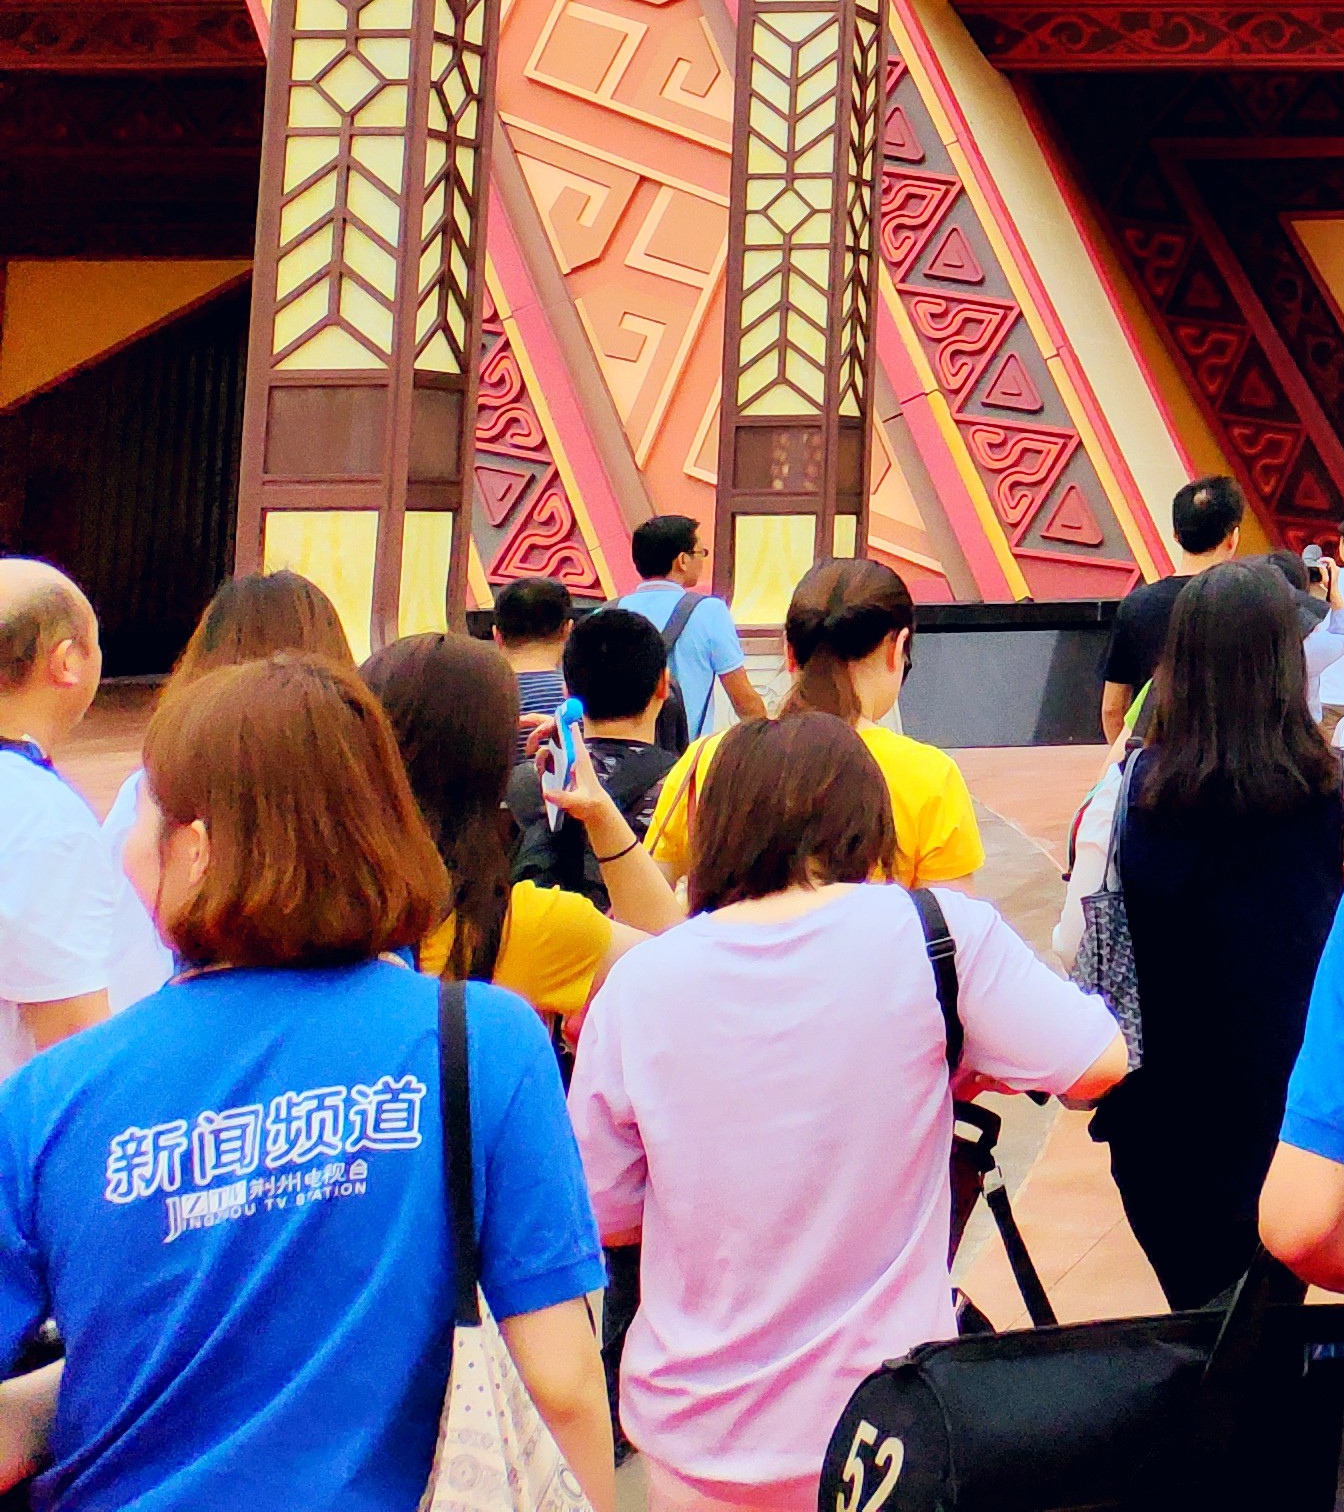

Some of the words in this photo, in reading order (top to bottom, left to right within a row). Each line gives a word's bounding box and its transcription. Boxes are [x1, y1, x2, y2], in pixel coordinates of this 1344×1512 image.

[104, 1073, 427, 1204] 新闻频道
[250, 1158, 368, 1200] 荆州电视台
[264, 1197, 287, 1213] TV
[836, 1419, 904, 1512] 52
